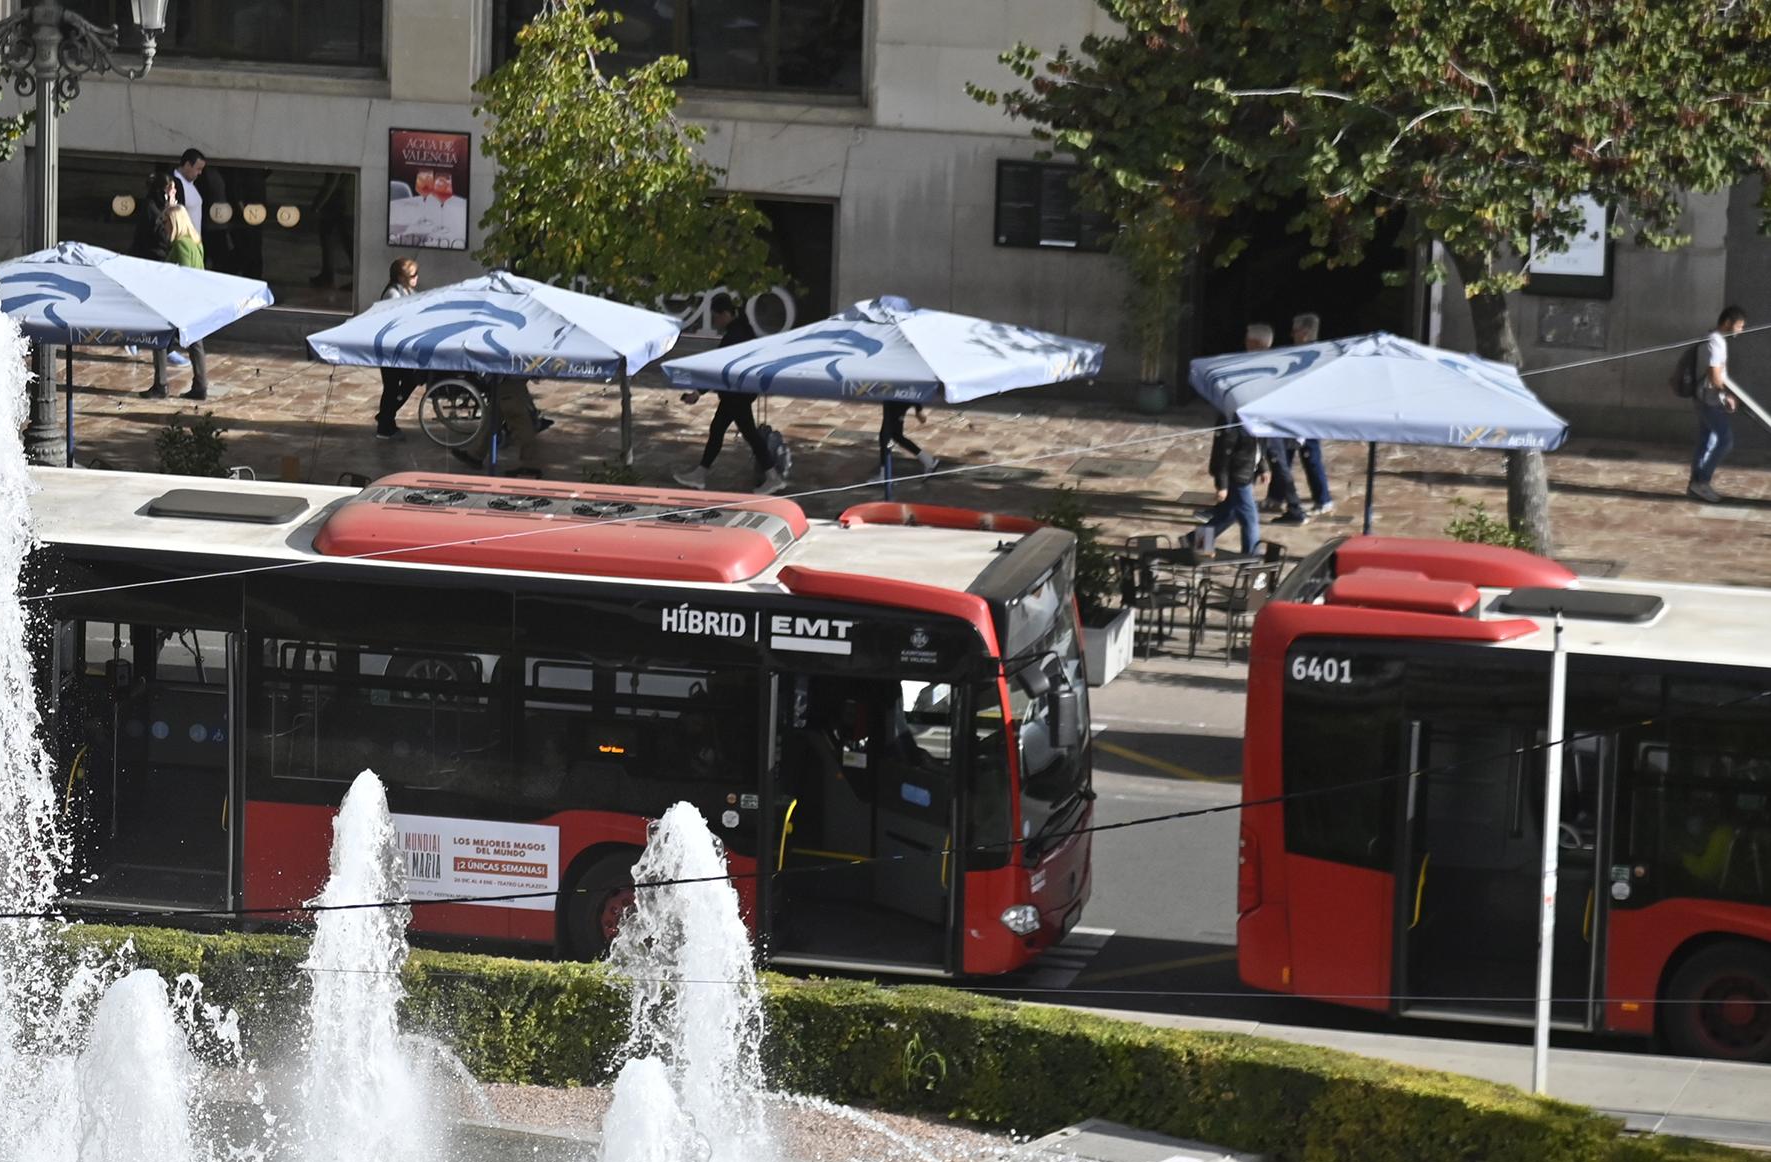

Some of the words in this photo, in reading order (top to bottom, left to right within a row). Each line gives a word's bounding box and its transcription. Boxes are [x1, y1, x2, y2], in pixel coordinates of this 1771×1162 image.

[405, 137, 437, 151] AGUA
[402, 149, 458, 164] VALENCIA
[661, 602, 746, 638] HÍBRID
[771, 615, 854, 639] EMT
[1292, 656, 1353, 684] 6401
[404, 832, 441, 853] MUNDIAL
[453, 837, 470, 846] LOS
[473, 839, 511, 849] MEJORES
[513, 842, 546, 851] MAGOS
[476, 847, 490, 855] DEL
[493, 848, 526, 858] MUNDO
[412, 852, 441, 879] MAGIA
[468, 860, 499, 872] ÚNICAS
[501, 863, 546, 875] SEMANAS!
